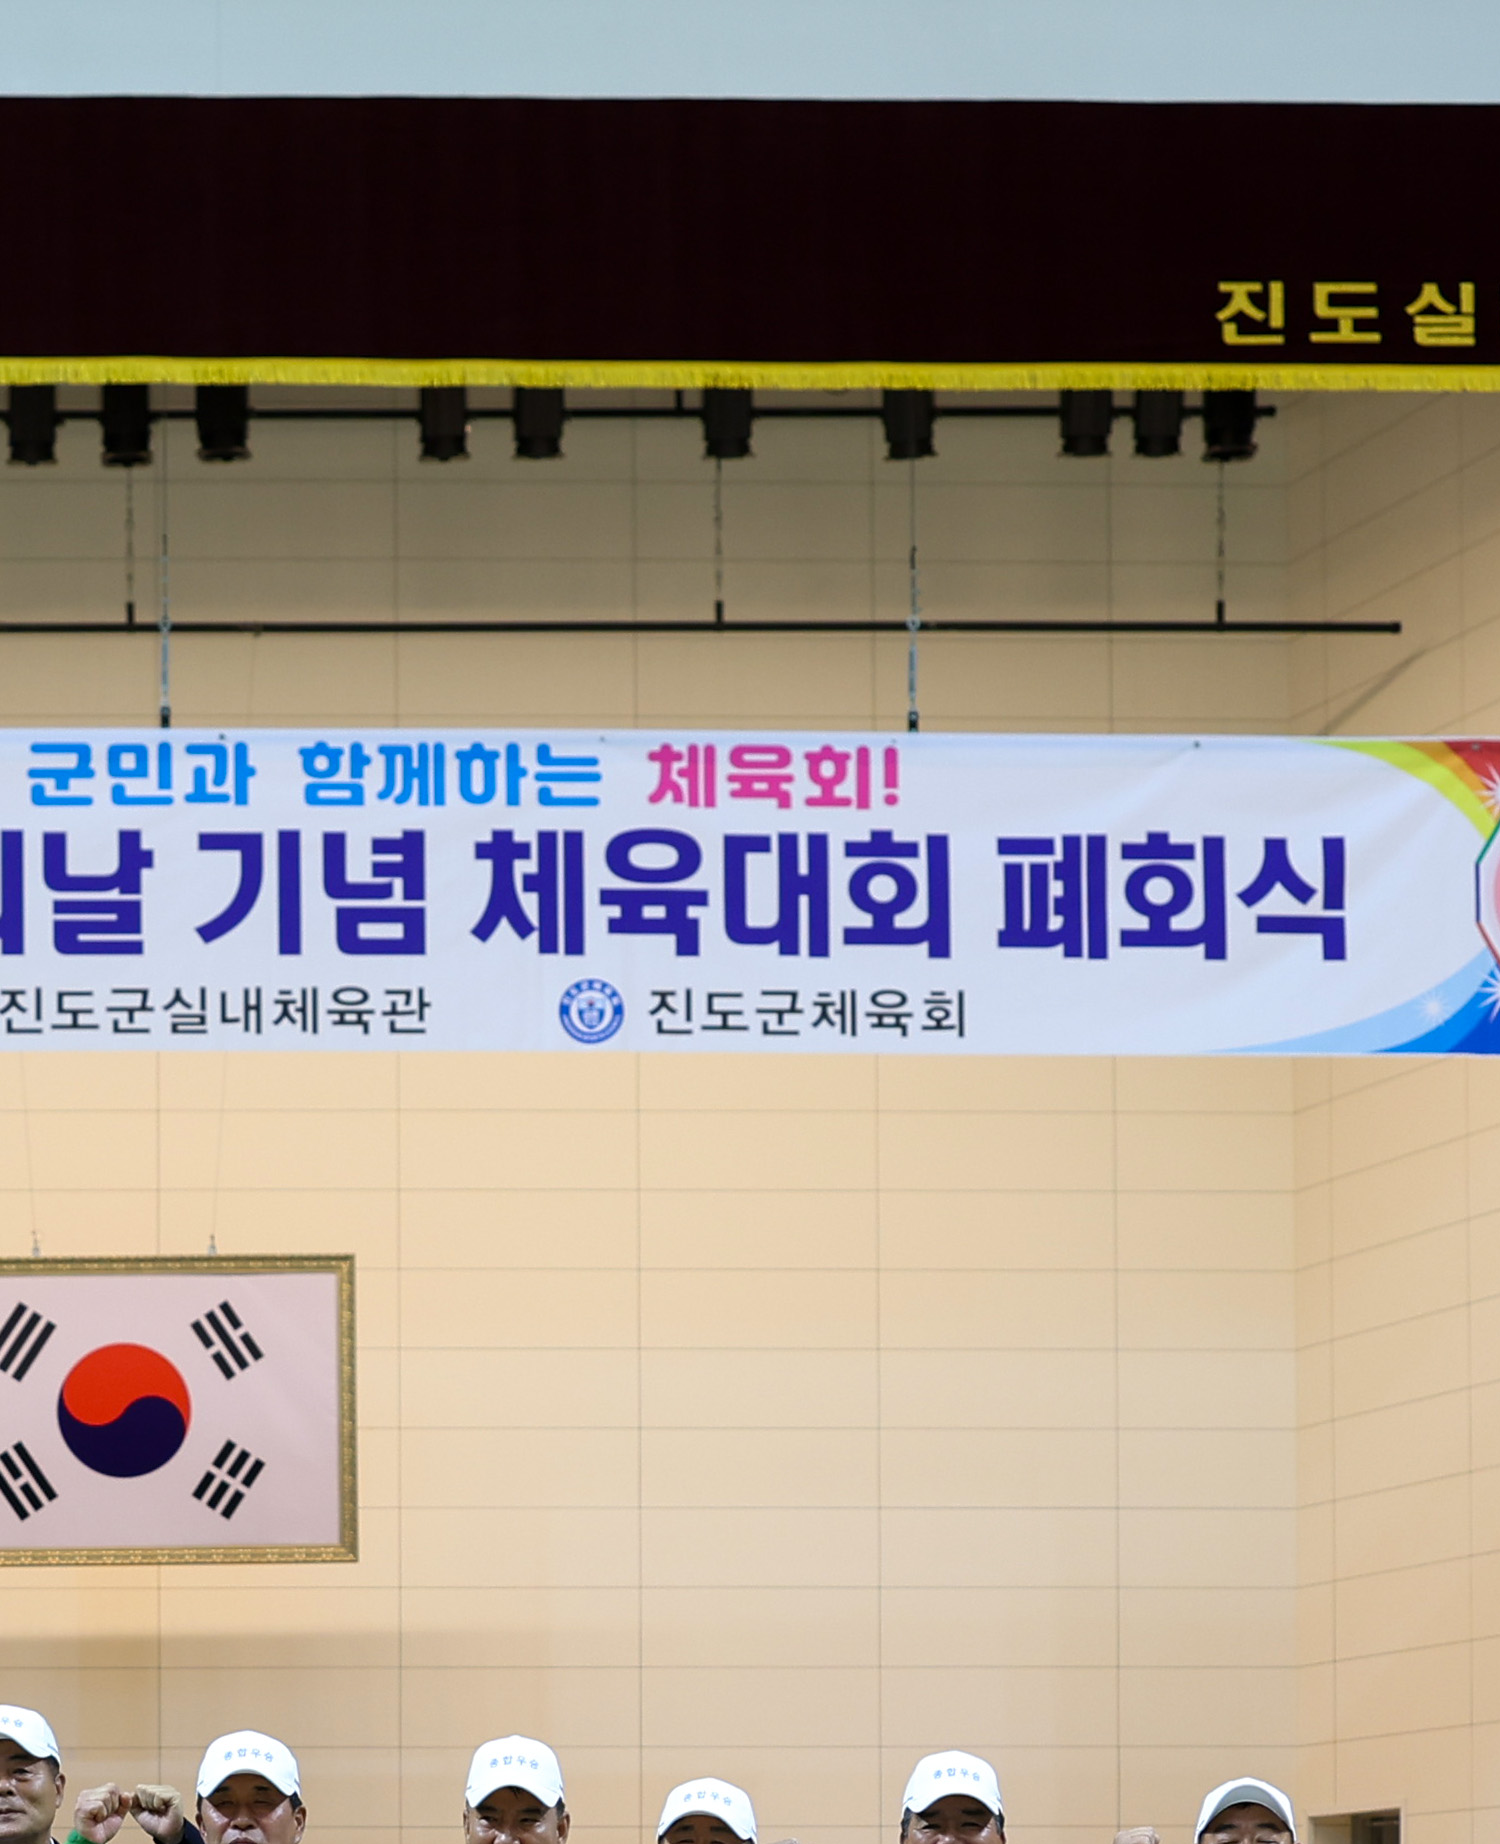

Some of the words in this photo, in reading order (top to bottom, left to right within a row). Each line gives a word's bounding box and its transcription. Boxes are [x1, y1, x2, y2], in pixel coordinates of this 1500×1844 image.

[28, 742, 256, 806] 군민과
[299, 741, 601, 806] 함께하는
[648, 744, 900, 809] 체육회!
[195, 829, 428, 956] 기념
[470, 828, 951, 959] 체육대회
[997, 831, 1347, 961] 폐회식
[0, 986, 431, 1036] 진도군실내체육관
[649, 988, 966, 1038] 진도군체육회
